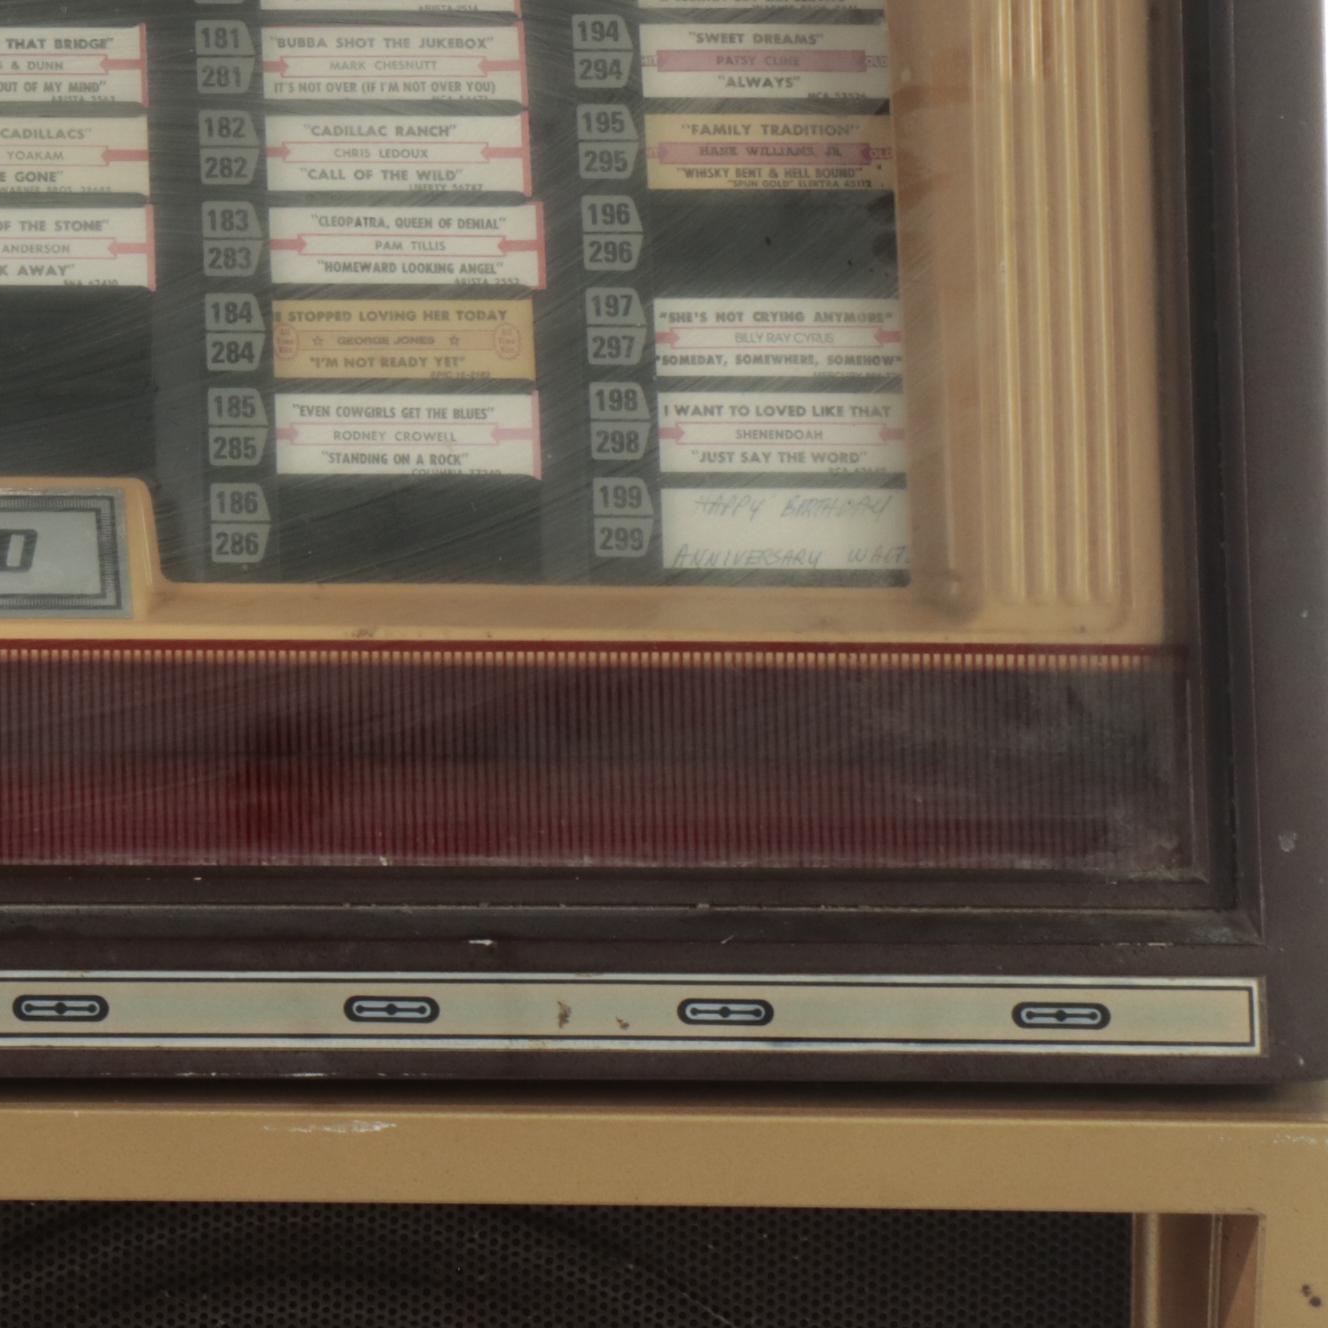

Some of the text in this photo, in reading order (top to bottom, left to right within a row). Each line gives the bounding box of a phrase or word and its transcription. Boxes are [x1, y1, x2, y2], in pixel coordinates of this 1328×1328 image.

[270, 36, 494, 50] "BUBBA SHOT THE JUKEBOX"
[689, 32, 823, 45] "SWEET DREAMS"
[718, 76, 800, 89] "ALWAYS"
[582, 111, 625, 133] 195
[681, 123, 860, 136] "FAMILY TRADITION"
[20, 221, 48, 232] THE
[54, 219, 109, 232] STONE"
[1, 243, 71, 254] ANDERSON
[375, 241, 446, 252] PAM TILLIS
[589, 241, 632, 262] 296
[208, 247, 252, 269] 283
[17, 263, 75, 277] AWAY"
[664, 406, 891, 418] I WANT TO LOVED LIKE THAT
[333, 431, 457, 443] RODNEY CROWELL
[596, 431, 640, 452] 298
[735, 430, 823, 440] SHENENDOAH
[214, 438, 257, 460] 285
[691, 450, 867, 464] "JUST SAY THE WORD"
